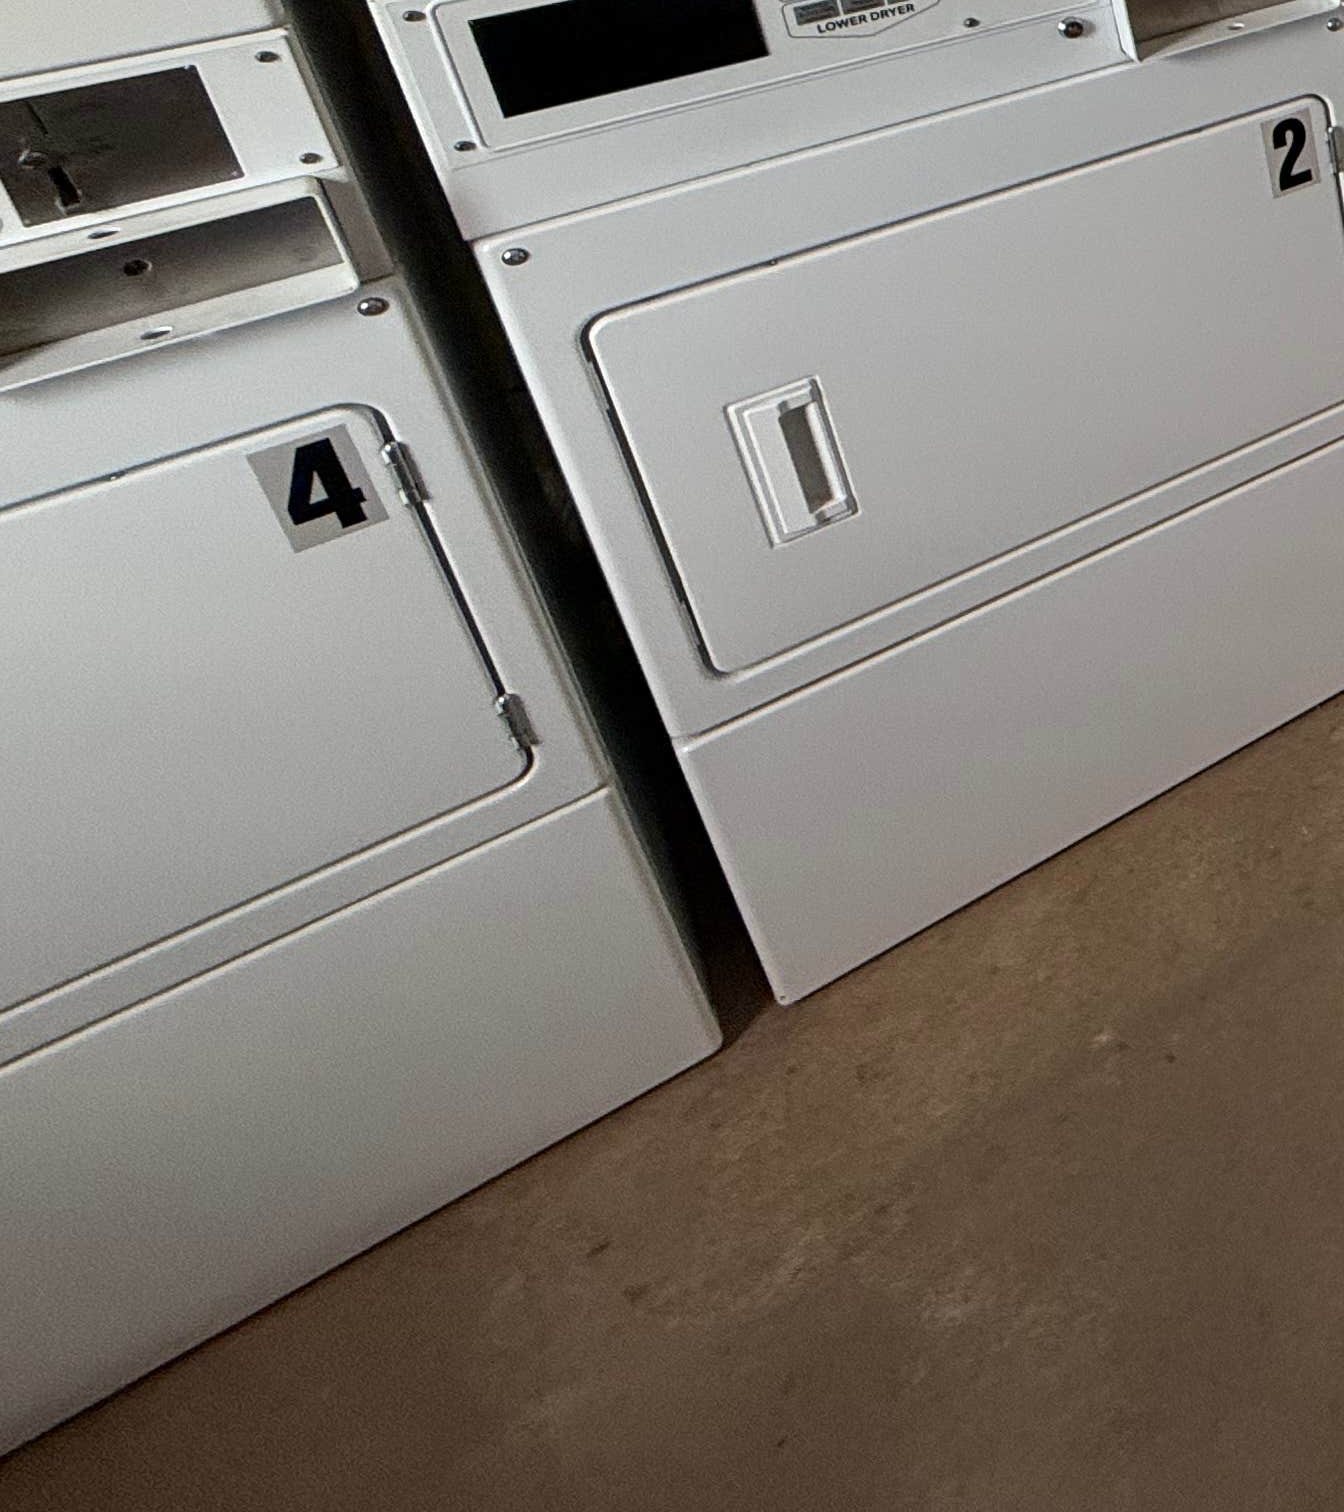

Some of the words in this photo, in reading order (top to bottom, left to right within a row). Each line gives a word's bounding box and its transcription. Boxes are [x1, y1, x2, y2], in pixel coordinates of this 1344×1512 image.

[816, 14, 868, 34] LOWER
[870, 3, 916, 22] DRYER
[1272, 118, 1313, 192] 2
[287, 437, 368, 530] 4
